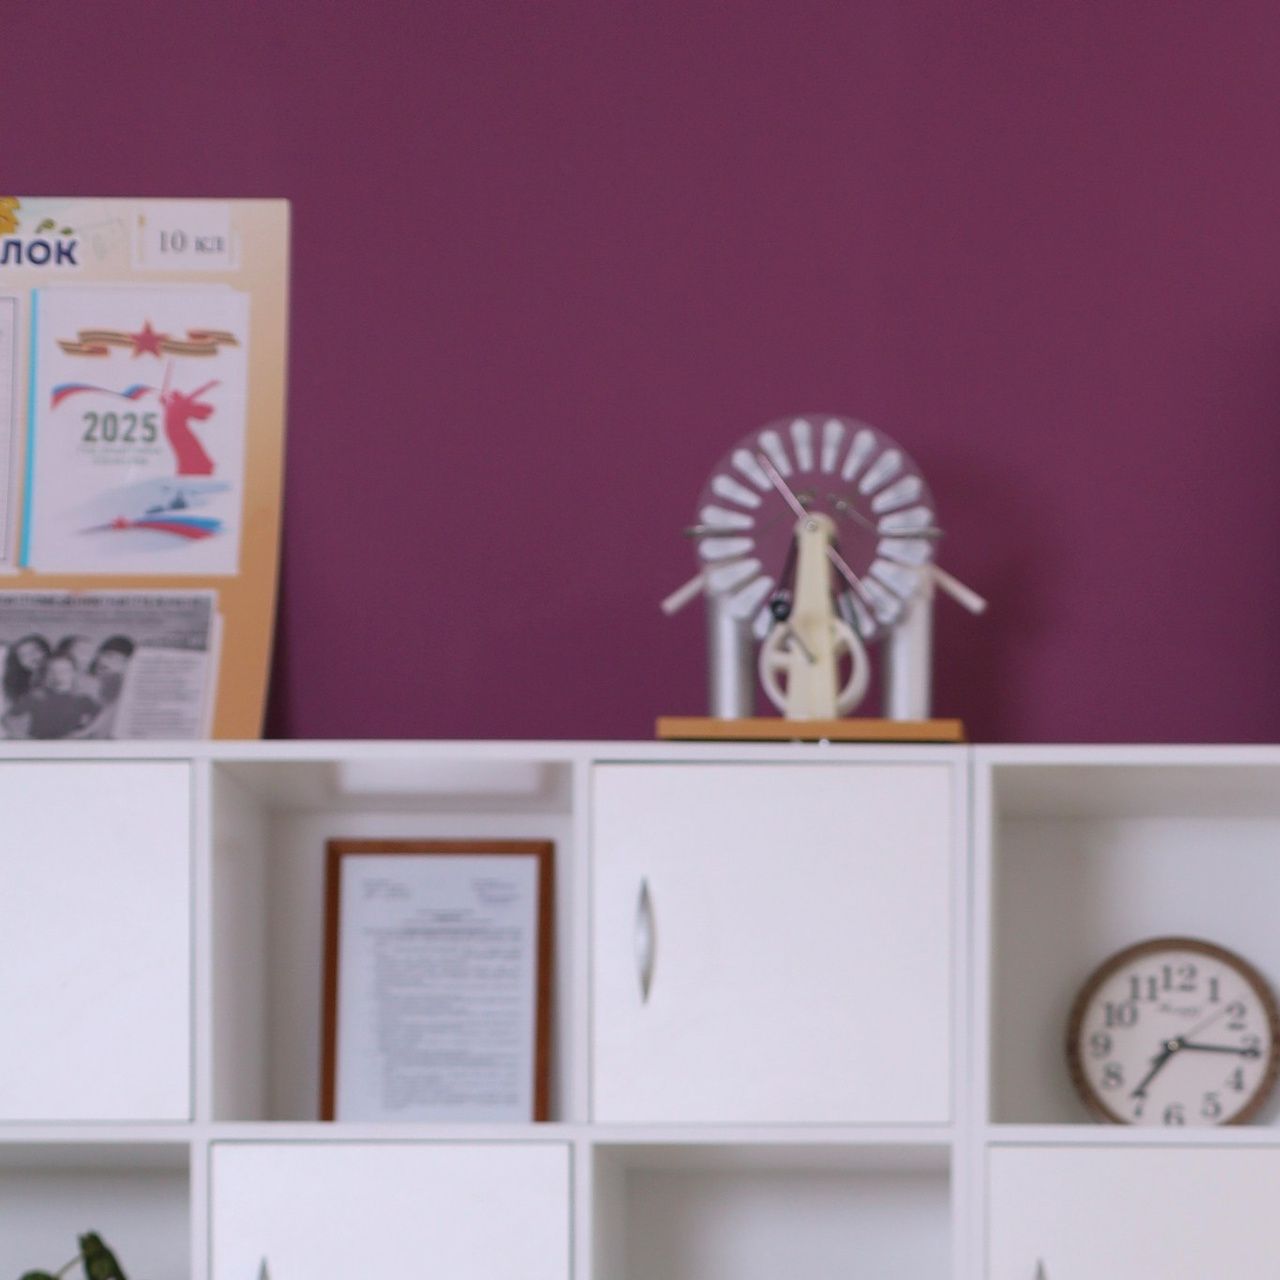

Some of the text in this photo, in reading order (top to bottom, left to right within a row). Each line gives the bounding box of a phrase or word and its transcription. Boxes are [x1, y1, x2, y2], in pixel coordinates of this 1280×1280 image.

[159, 230, 187, 252] 10
[82, 412, 158, 443] 2025
[1130, 975, 1158, 1002] 11
[1162, 965, 1197, 991] 12
[1209, 977, 1219, 1003] 1
[1105, 1001, 1138, 1028] 10
[1225, 1003, 1246, 1031] 2
[1091, 1034, 1112, 1057] 9
[1102, 1063, 1123, 1089] 8
[1227, 1067, 1244, 1091] 4
